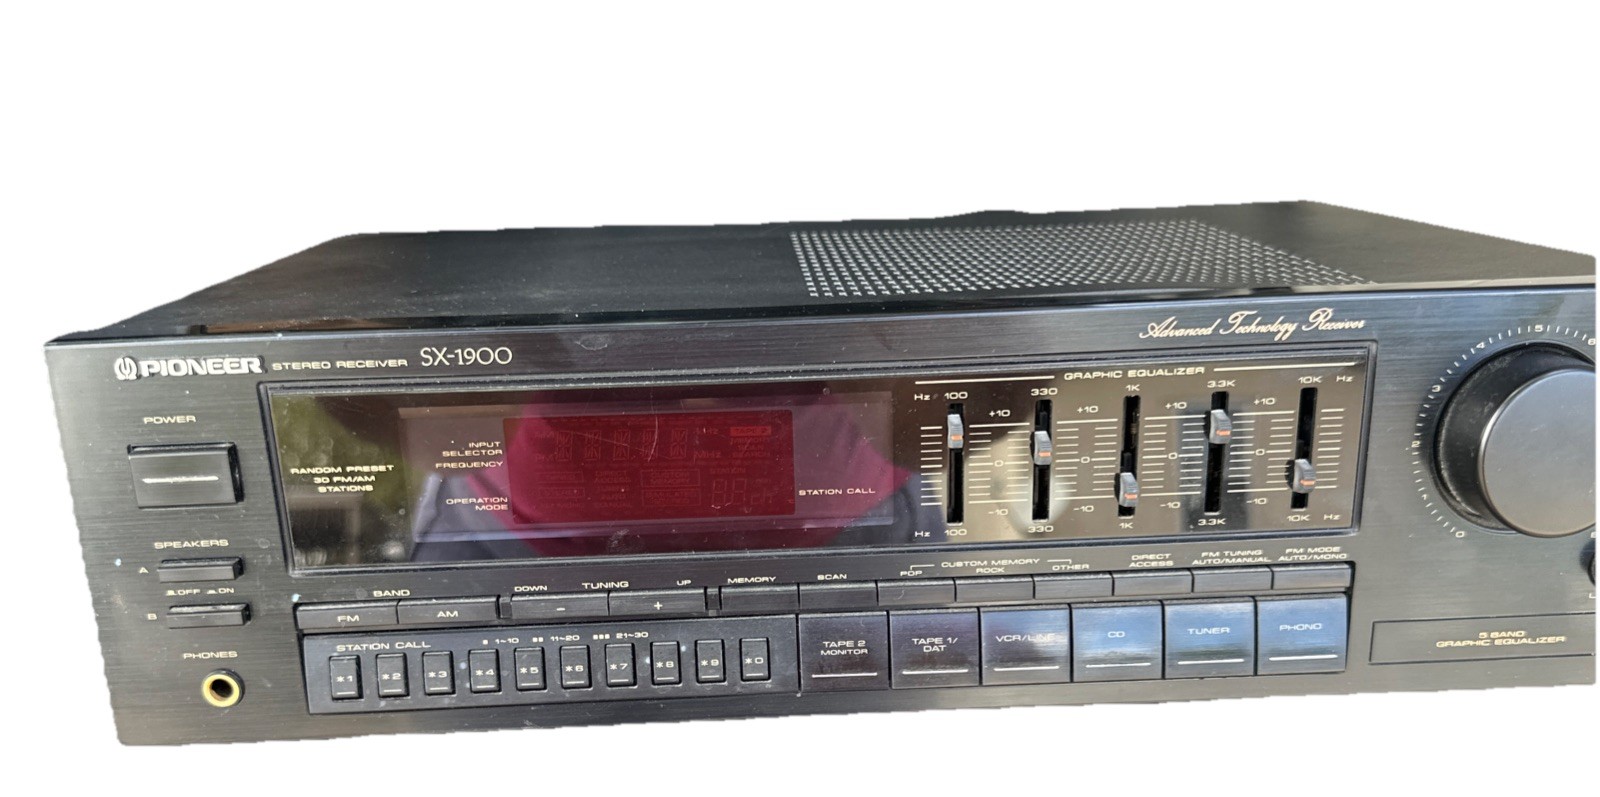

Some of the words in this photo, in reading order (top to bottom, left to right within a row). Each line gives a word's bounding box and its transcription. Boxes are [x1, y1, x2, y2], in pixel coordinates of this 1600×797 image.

[1139, 315, 1220, 339] Advanced
[1219, 311, 1298, 342] Technology
[1302, 308, 1366, 331] Receiver
[1534, 324, 1543, 332] 5
[1475, 341, 1486, 349] 4
[420, 346, 512, 367] SX-1900
[140, 357, 263, 377] PIONEER
[272, 361, 331, 371] STEREO
[336, 359, 408, 369] RECEIVER
[1064, 370, 1122, 380] GRAPHIC
[1127, 367, 1205, 378] EQUALIZER
[914, 393, 930, 401] Hz
[944, 391, 968, 400] 100
[1031, 387, 1058, 396] 330
[1125, 383, 1140, 392] 1K
[1207, 379, 1235, 388] 3.3K
[1298, 375, 1322, 384] 10K
[1336, 375, 1353, 383] Hz
[1432, 384, 1441, 393] 3
[1165, 402, 1186, 410] +10
[1254, 398, 1275, 406] +10
[989, 409, 1010, 418] +10
[1077, 405, 1098, 414] +10
[143, 415, 196, 424] POWER
[468, 441, 501, 449] INPUT
[1411, 440, 1420, 448] 2
[442, 449, 503, 457] SELECTOR
[435, 460, 503, 469] FREQUENCY
[1081, 456, 1090, 464] 0
[291, 465, 342, 474] RANDOM
[346, 464, 394, 473] PRESET
[314, 476, 328, 484] 30
[332, 475, 376, 483] FM/AM
[318, 484, 374, 493] STATIONS
[799, 488, 842, 497] STATION
[847, 487, 876, 495] CALL
[446, 497, 508, 505] OPERATION
[1422, 493, 1428, 501] 1
[1160, 501, 1180, 509] -10
[1247, 498, 1267, 506] -10
[988, 508, 1008, 516] -10
[1074, 505, 1094, 513] -10
[915, 530, 930, 538] Hz
[943, 528, 967, 537] 100
[1027, 525, 1053, 533] 330
[1119, 522, 1133, 530] 1K
[1198, 518, 1226, 526] 3.3K
[1286, 514, 1310, 522] 10K
[1324, 513, 1341, 521] Hz
[1455, 530, 1465, 538] 0
[154, 539, 229, 549] SPEAKERS
[1201, 551, 1221, 560] FM
[1224, 549, 1263, 558] TUNING
[1285, 547, 1303, 556] FM
[1307, 546, 1341, 554] MODE
[1132, 553, 1172, 562] DIRECT
[1192, 556, 1272, 565] AUTO/MANUAL
[1278, 553, 1348, 562] AUTO/MONO
[941, 560, 988, 568] CUSTOM
[991, 558, 1040, 566] MEMORY
[1052, 562, 1090, 571] OTHER
[1129, 559, 1174, 568] ACCESS
[900, 569, 923, 578] POP
[976, 566, 1005, 574] ROCK
[727, 576, 777, 584] MEMORY
[817, 573, 847, 581] SCAN
[514, 584, 548, 592] DOWN
[582, 580, 629, 589] TUNING
[177, 588, 201, 596] OFF
[219, 587, 234, 595] ON
[373, 588, 411, 597] BAND
[338, 614, 359, 622] FM
[437, 610, 459, 618] AM
[1187, 626, 1230, 636] TUNER
[1280, 622, 1323, 631] PHONO
[550, 634, 580, 642] 11~20
[616, 631, 648, 639] 21~30
[1108, 630, 1126, 639] CD
[1490, 630, 1526, 638] BAND
[495, 637, 519, 645] 1~10
[822, 641, 854, 649] TAPE
[912, 638, 944, 647] TAPE
[947, 636, 959, 646] 1/
[1436, 640, 1491, 648] GRAPHIC
[1494, 636, 1566, 645] EQUALIZER
[336, 642, 391, 652] STATION
[395, 640, 431, 650] CALL
[923, 643, 947, 653] DAT
[183, 650, 238, 660] PHONES
[820, 647, 868, 655] MONITOR
